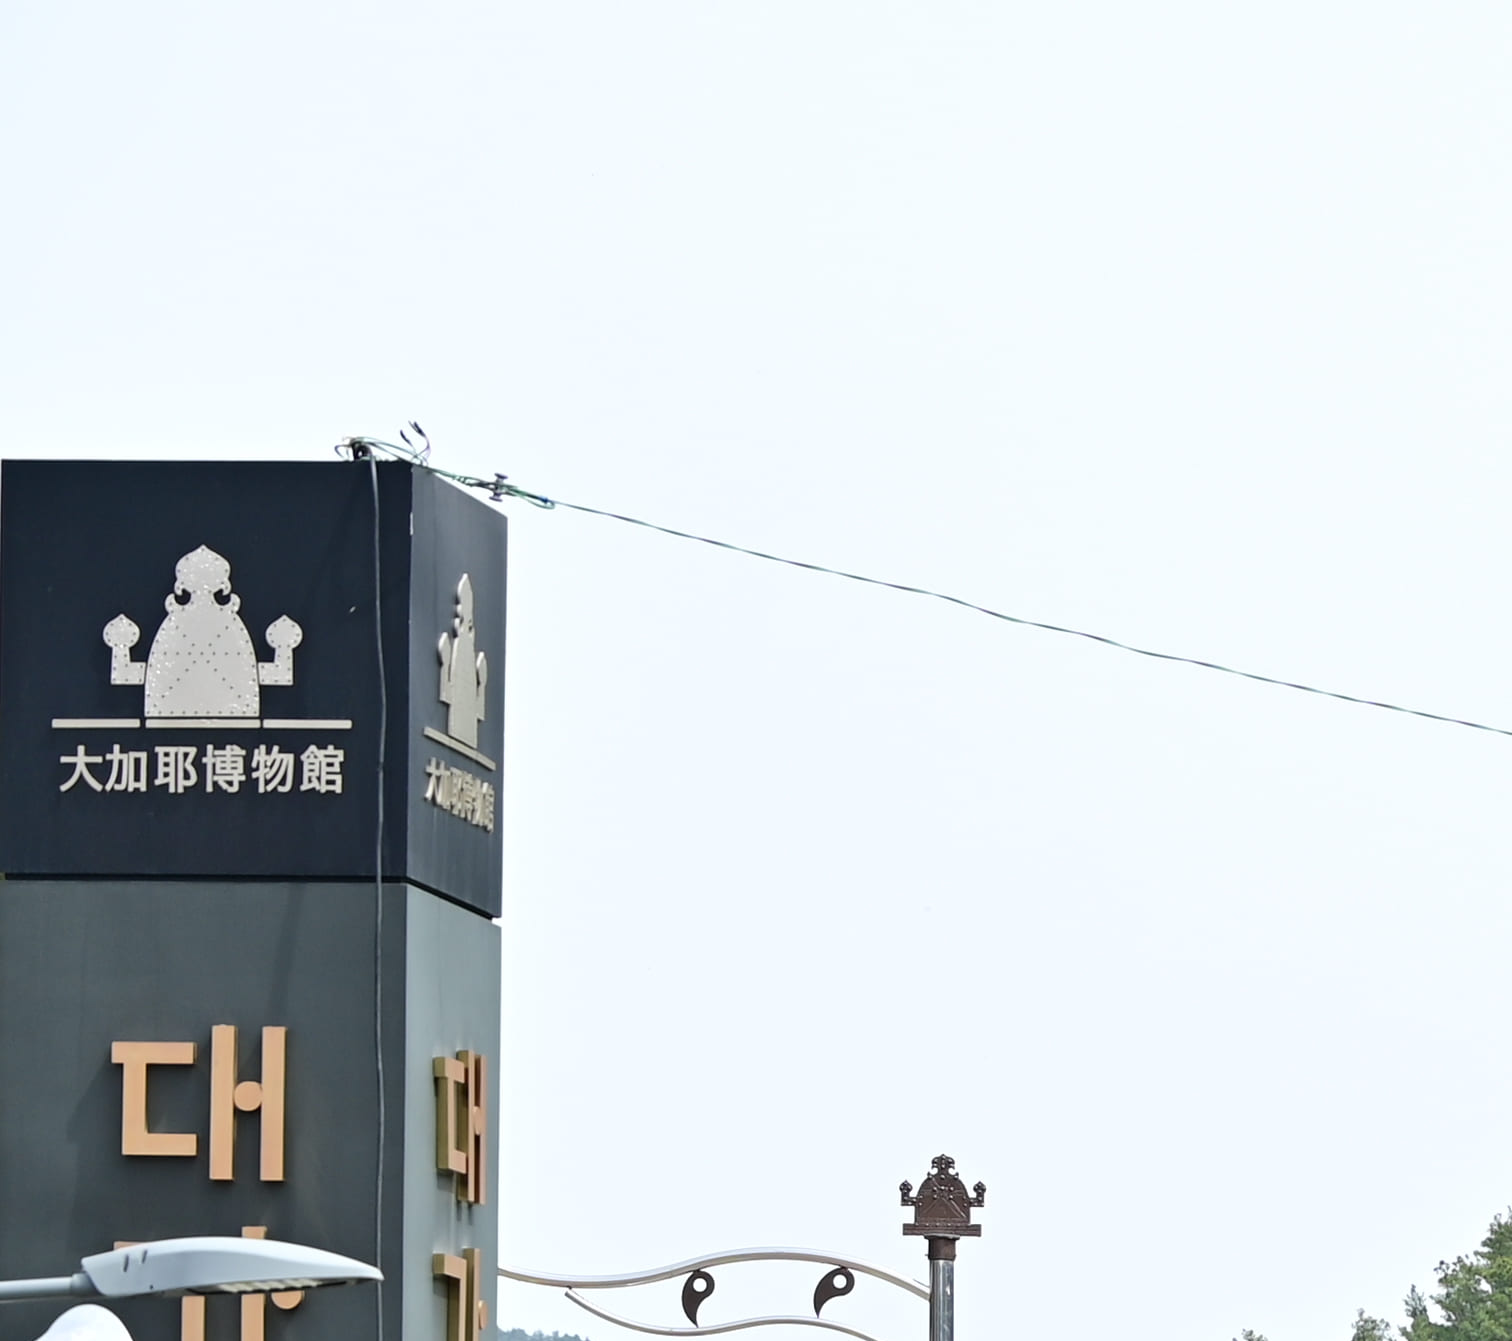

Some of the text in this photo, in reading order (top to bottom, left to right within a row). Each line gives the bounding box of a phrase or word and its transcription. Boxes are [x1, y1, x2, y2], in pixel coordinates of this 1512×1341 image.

[59, 744, 346, 795] 大加耶博物館
